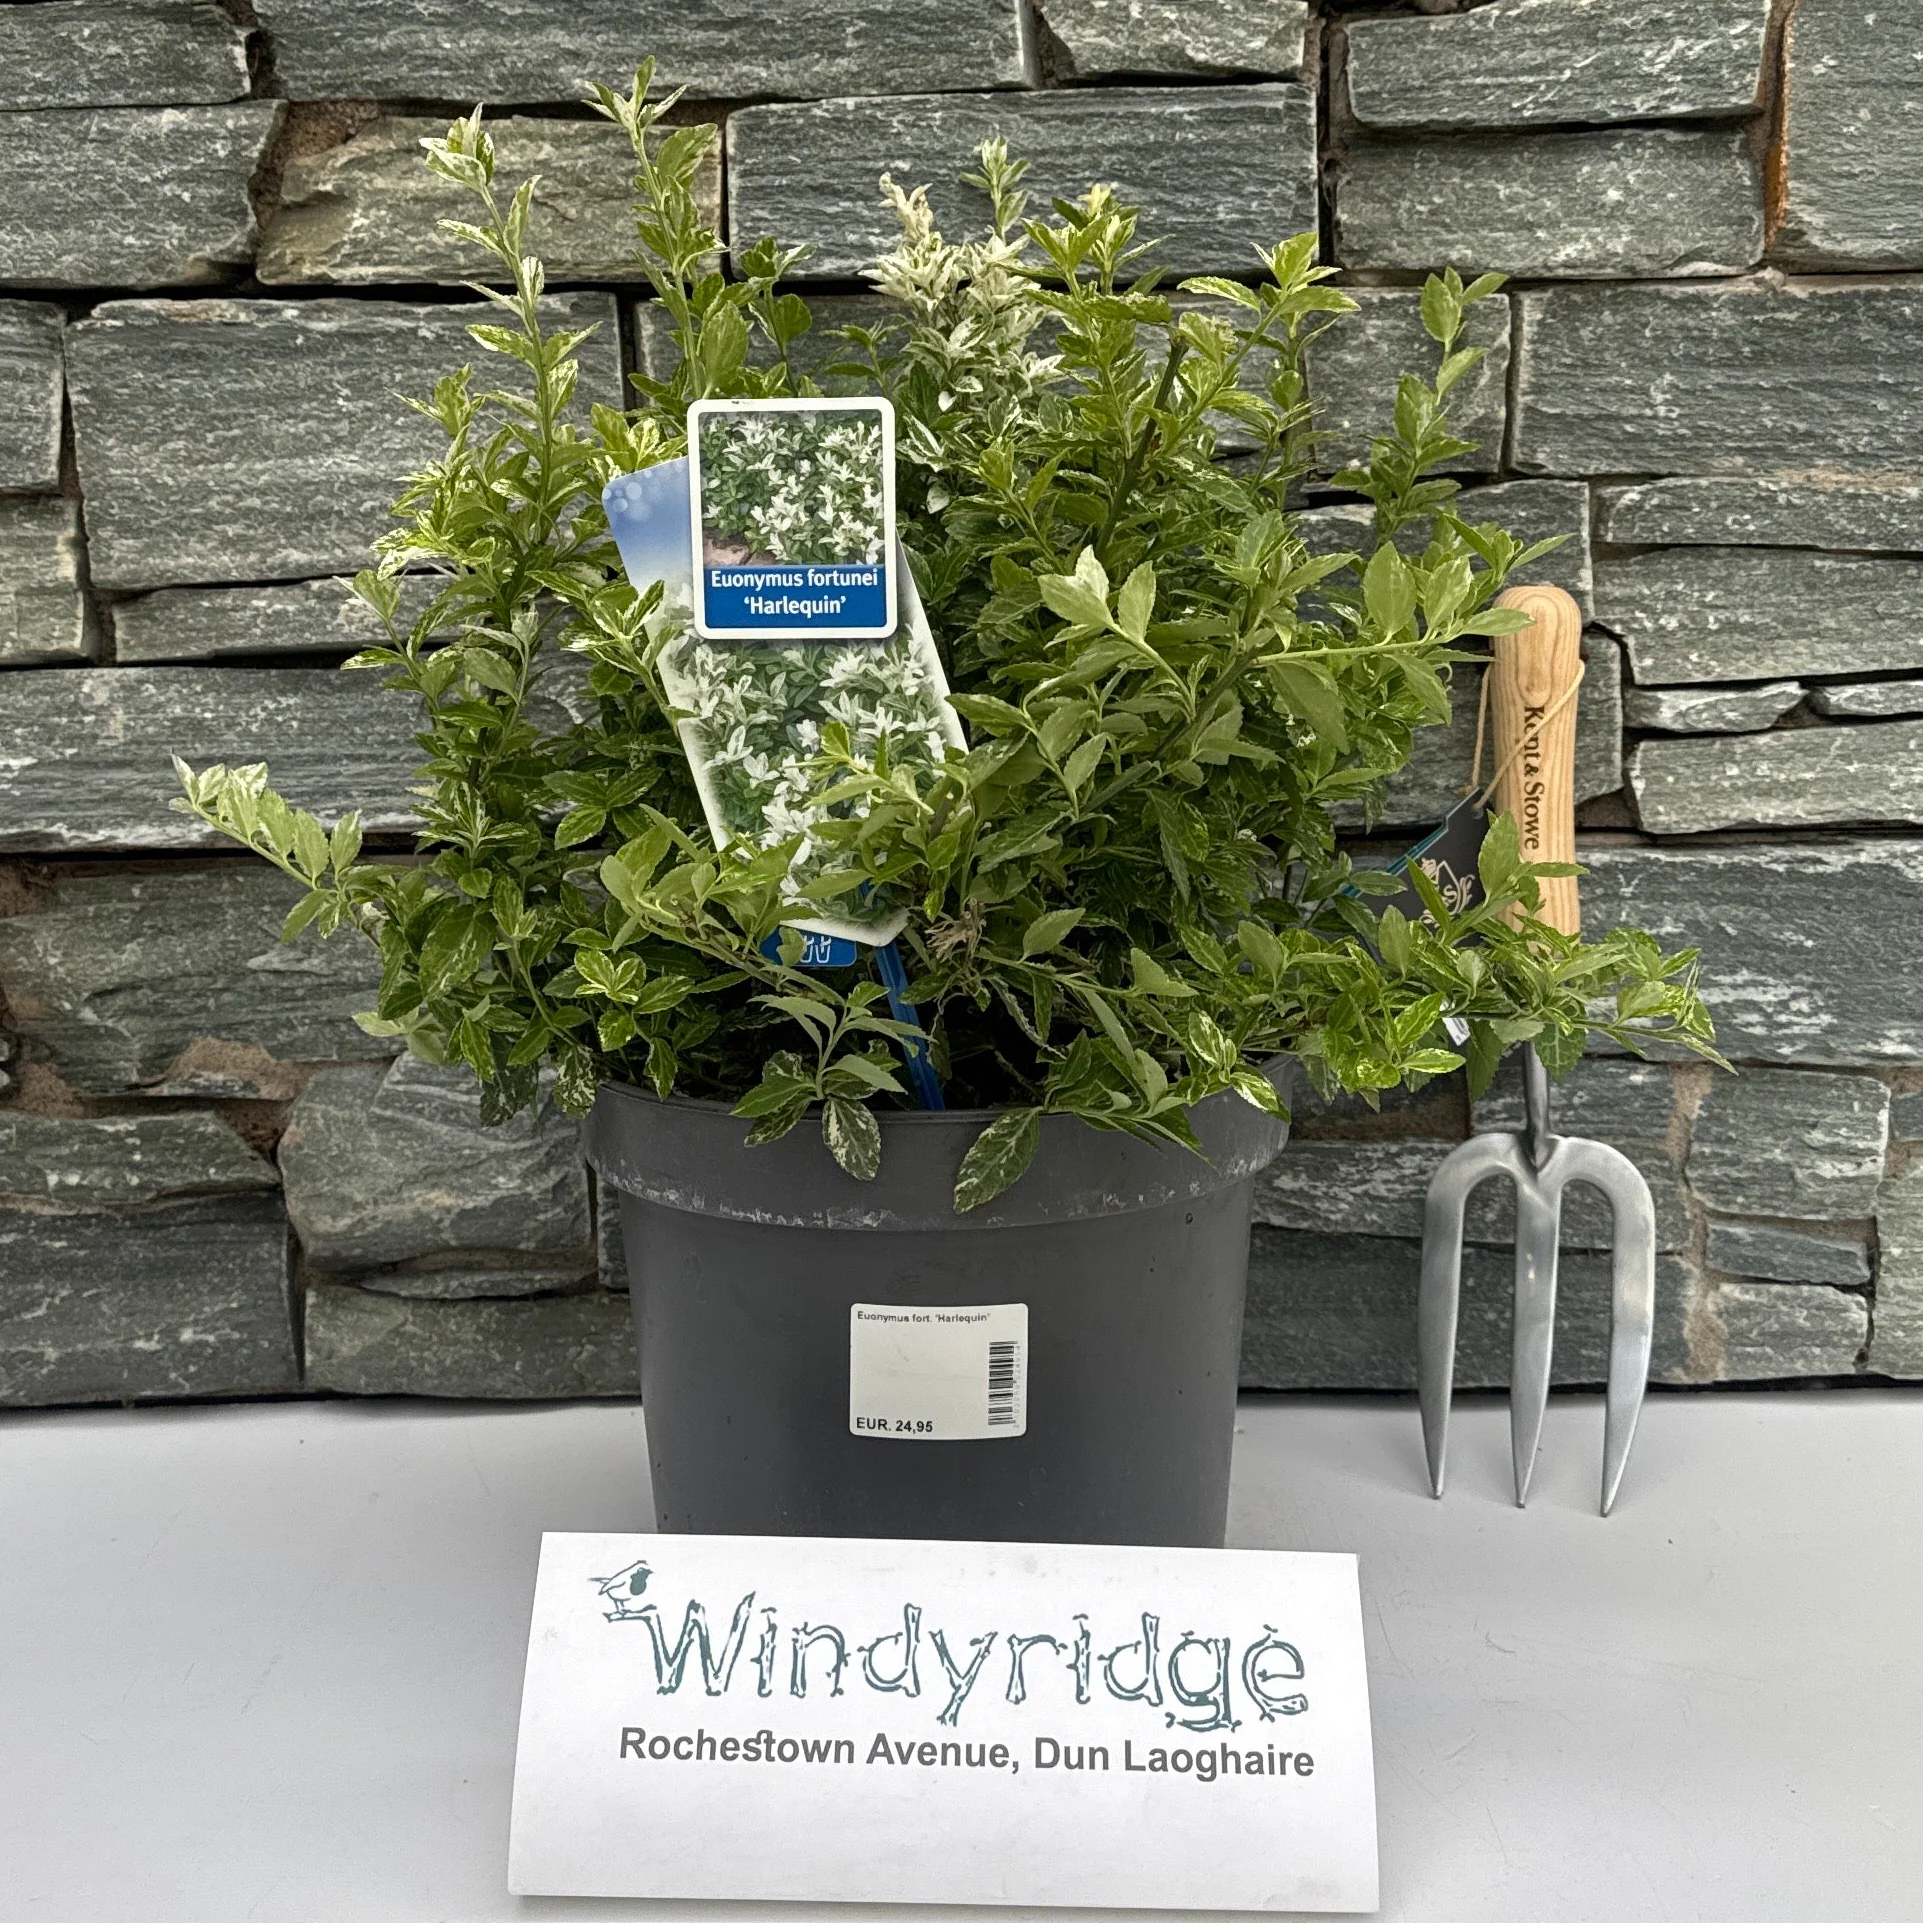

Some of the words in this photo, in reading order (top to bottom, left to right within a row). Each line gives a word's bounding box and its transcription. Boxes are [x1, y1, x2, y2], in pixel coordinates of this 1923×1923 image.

[711, 570, 803, 591] Euonymus
[807, 568, 878, 587] fortunei
[1523, 763, 1540, 778] &
[1523, 780, 1546, 850] Stowe
[857, 1310, 910, 1324] Euonymus
[856, 1416, 892, 1432] EUR.
[895, 1419, 934, 1434] 24,95
[603, 1591, 1309, 1733] Windyridge
[619, 1726, 855, 1764] Rochestown
[865, 1732, 1020, 1774] Avenue,
[1034, 1736, 1110, 1771] Dun
[1124, 1739, 1315, 1783] Laoghaire
